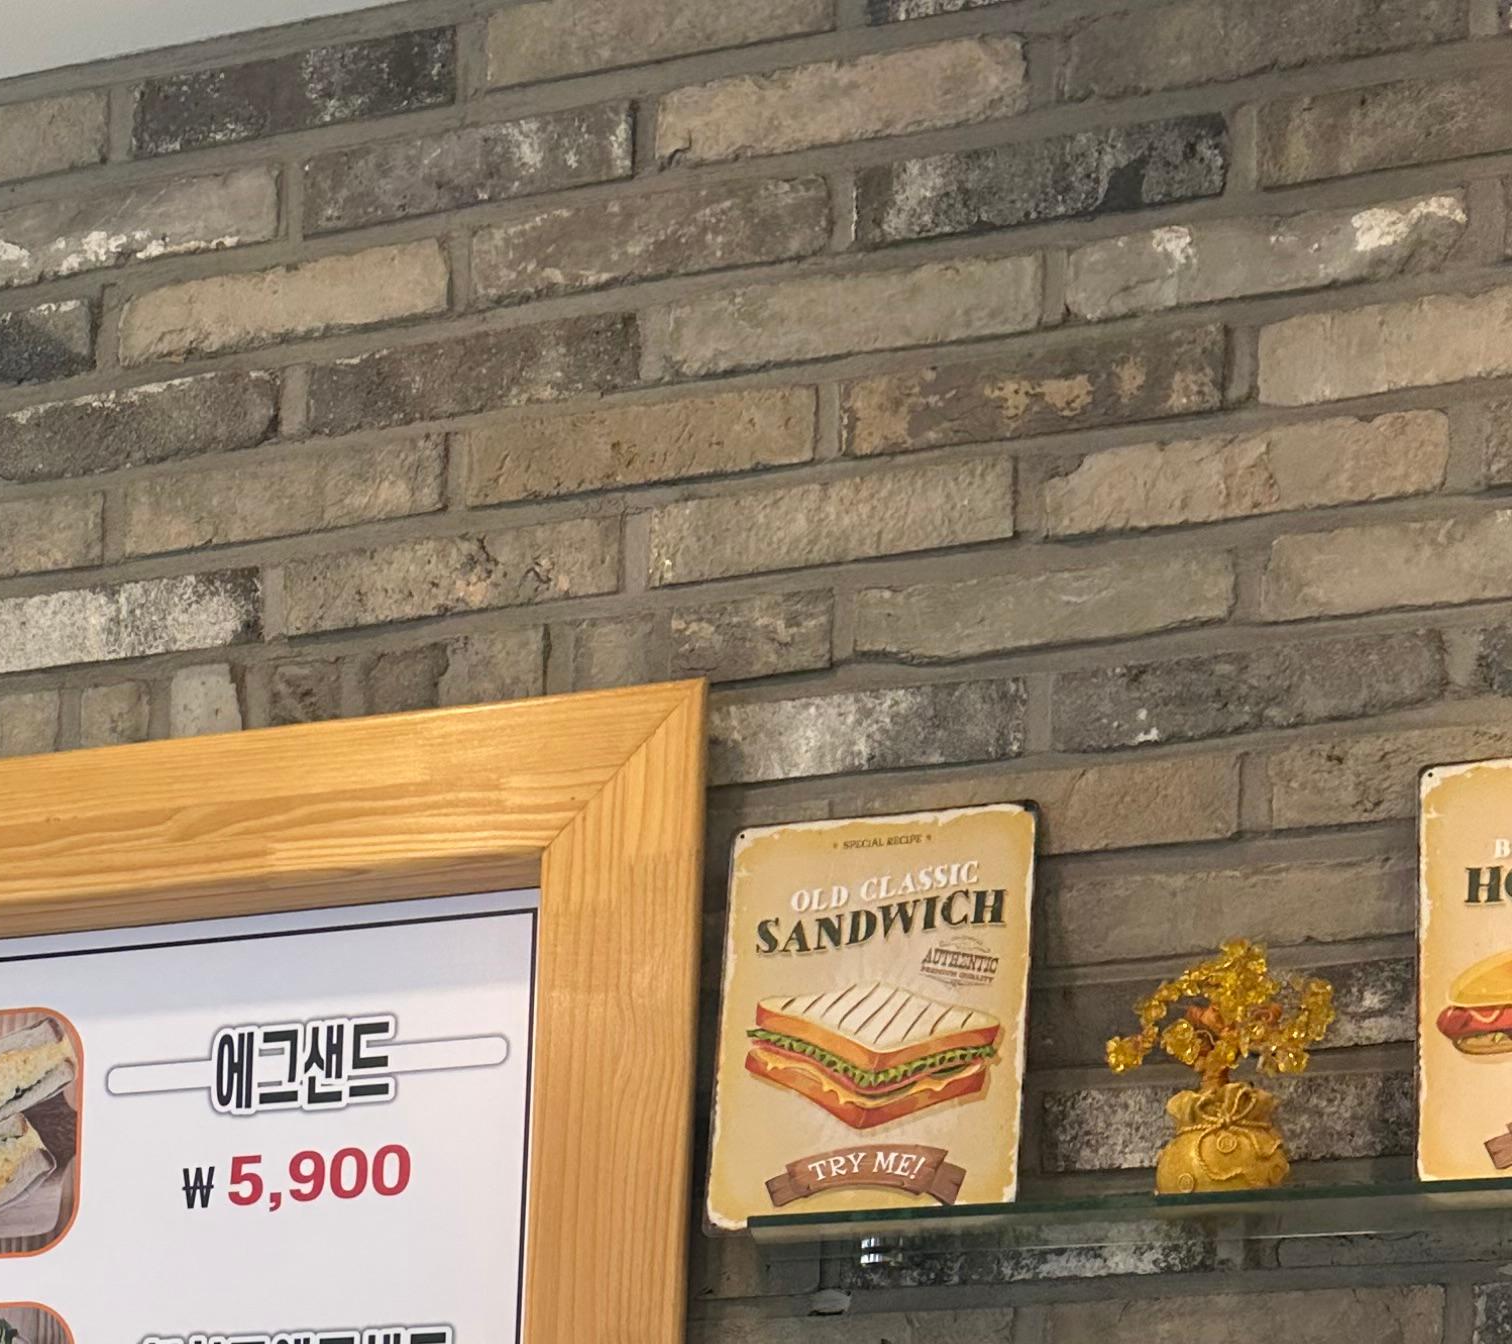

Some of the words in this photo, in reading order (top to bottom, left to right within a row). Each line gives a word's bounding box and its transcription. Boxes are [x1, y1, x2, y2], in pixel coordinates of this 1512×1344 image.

[843, 837, 884, 849] SPECIAL
[887, 833, 923, 846] RECIPE
[791, 885, 849, 913] OLD
[860, 860, 981, 901] CLASSIC
[756, 888, 1008, 954] SANDWICH
[921, 946, 999, 974] AUTHENTIC
[216, 1022, 389, 1109] 에그샌드
[808, 1151, 867, 1181] TRY
[872, 1151, 926, 1180] ME!
